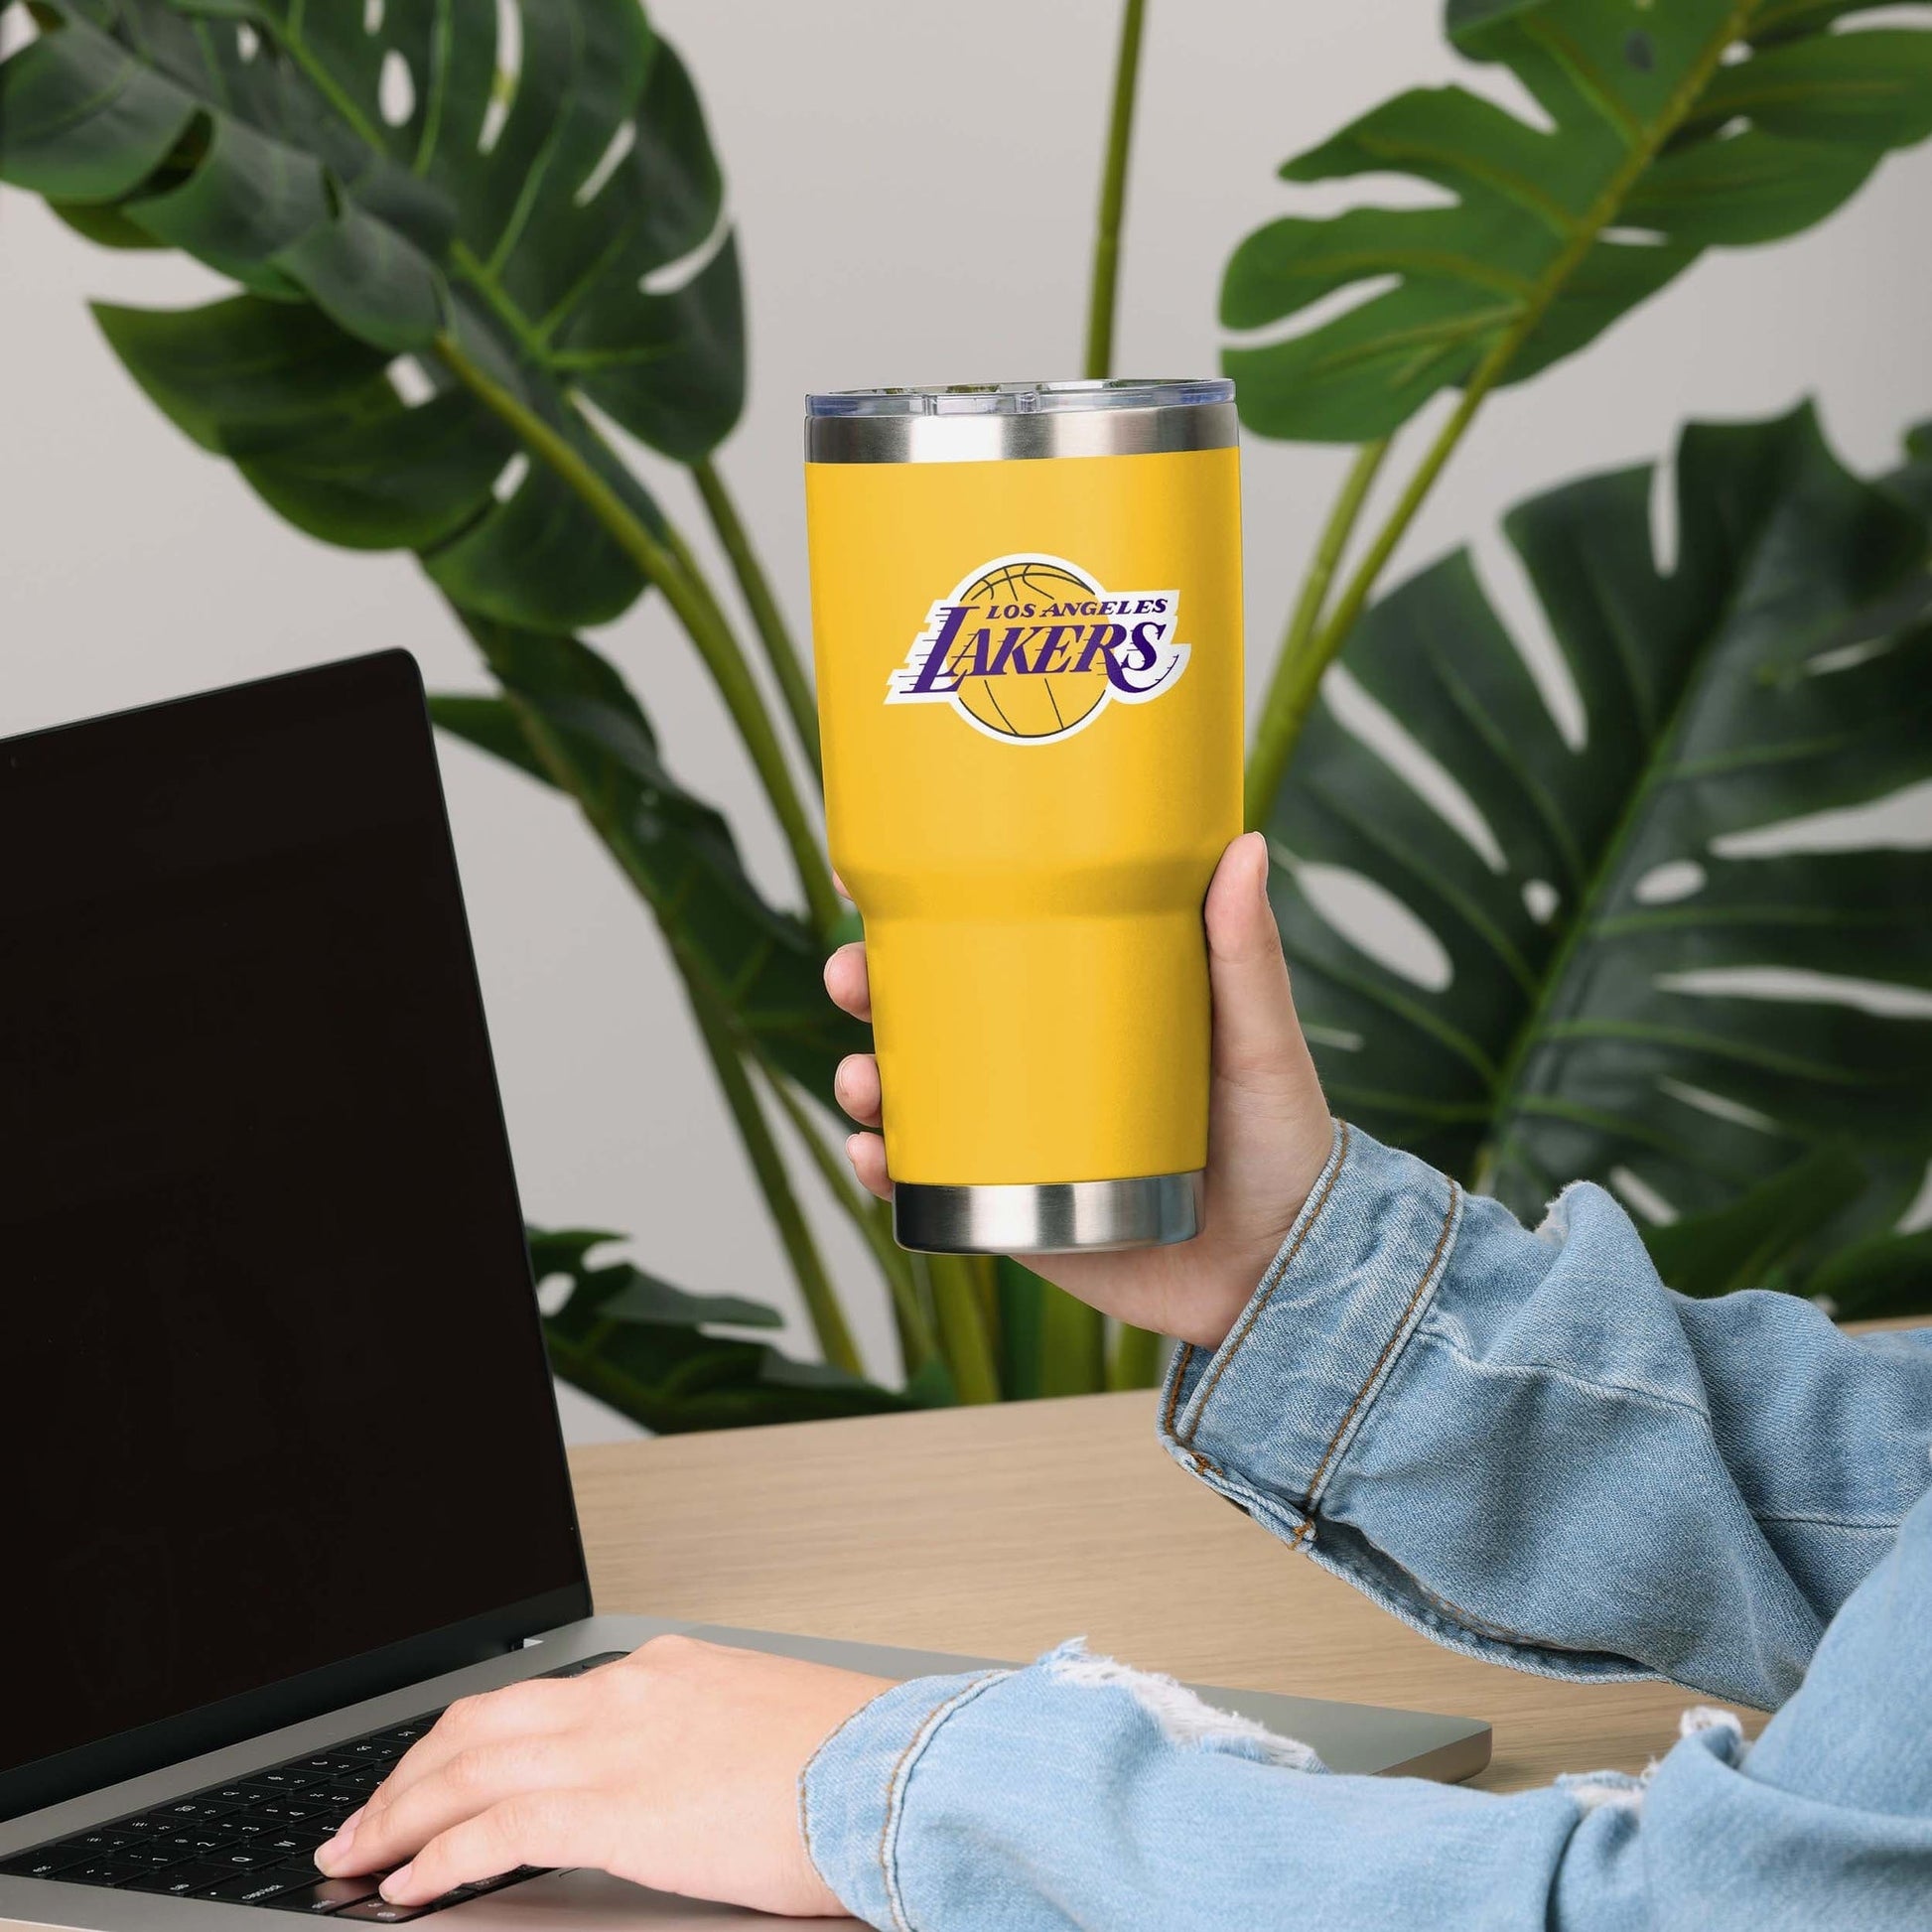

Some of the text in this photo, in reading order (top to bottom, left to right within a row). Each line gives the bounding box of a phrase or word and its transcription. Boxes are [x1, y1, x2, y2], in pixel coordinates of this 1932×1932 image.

[986, 599, 1169, 620] LOS ANGELES
[898, 606, 1179, 694] LAKERS
